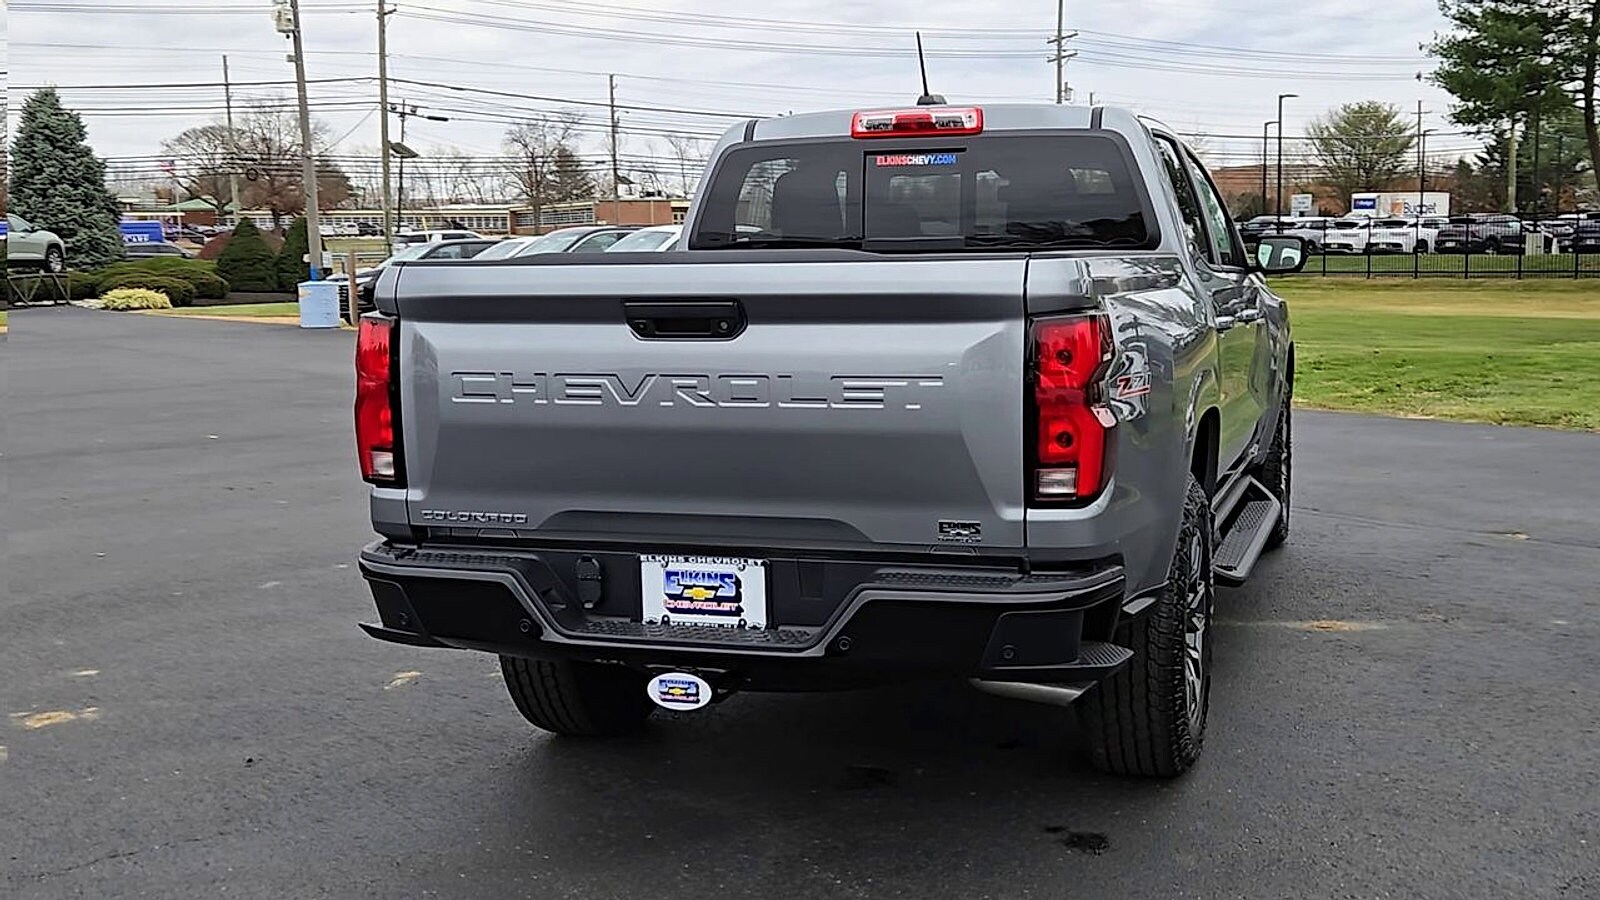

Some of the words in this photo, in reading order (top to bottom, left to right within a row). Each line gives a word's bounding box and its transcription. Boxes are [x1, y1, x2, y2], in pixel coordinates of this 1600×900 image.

[876, 154, 957, 166] ELKINSCHEVY.COM
[450, 371, 944, 410] CHEVROLET
[1116, 372, 1152, 400] Z71
[421, 509, 528, 523] COLORADO
[640, 554, 685, 563] ELKINS
[689, 556, 763, 567] CHEVROLET
[664, 570, 737, 597] ELKINS
